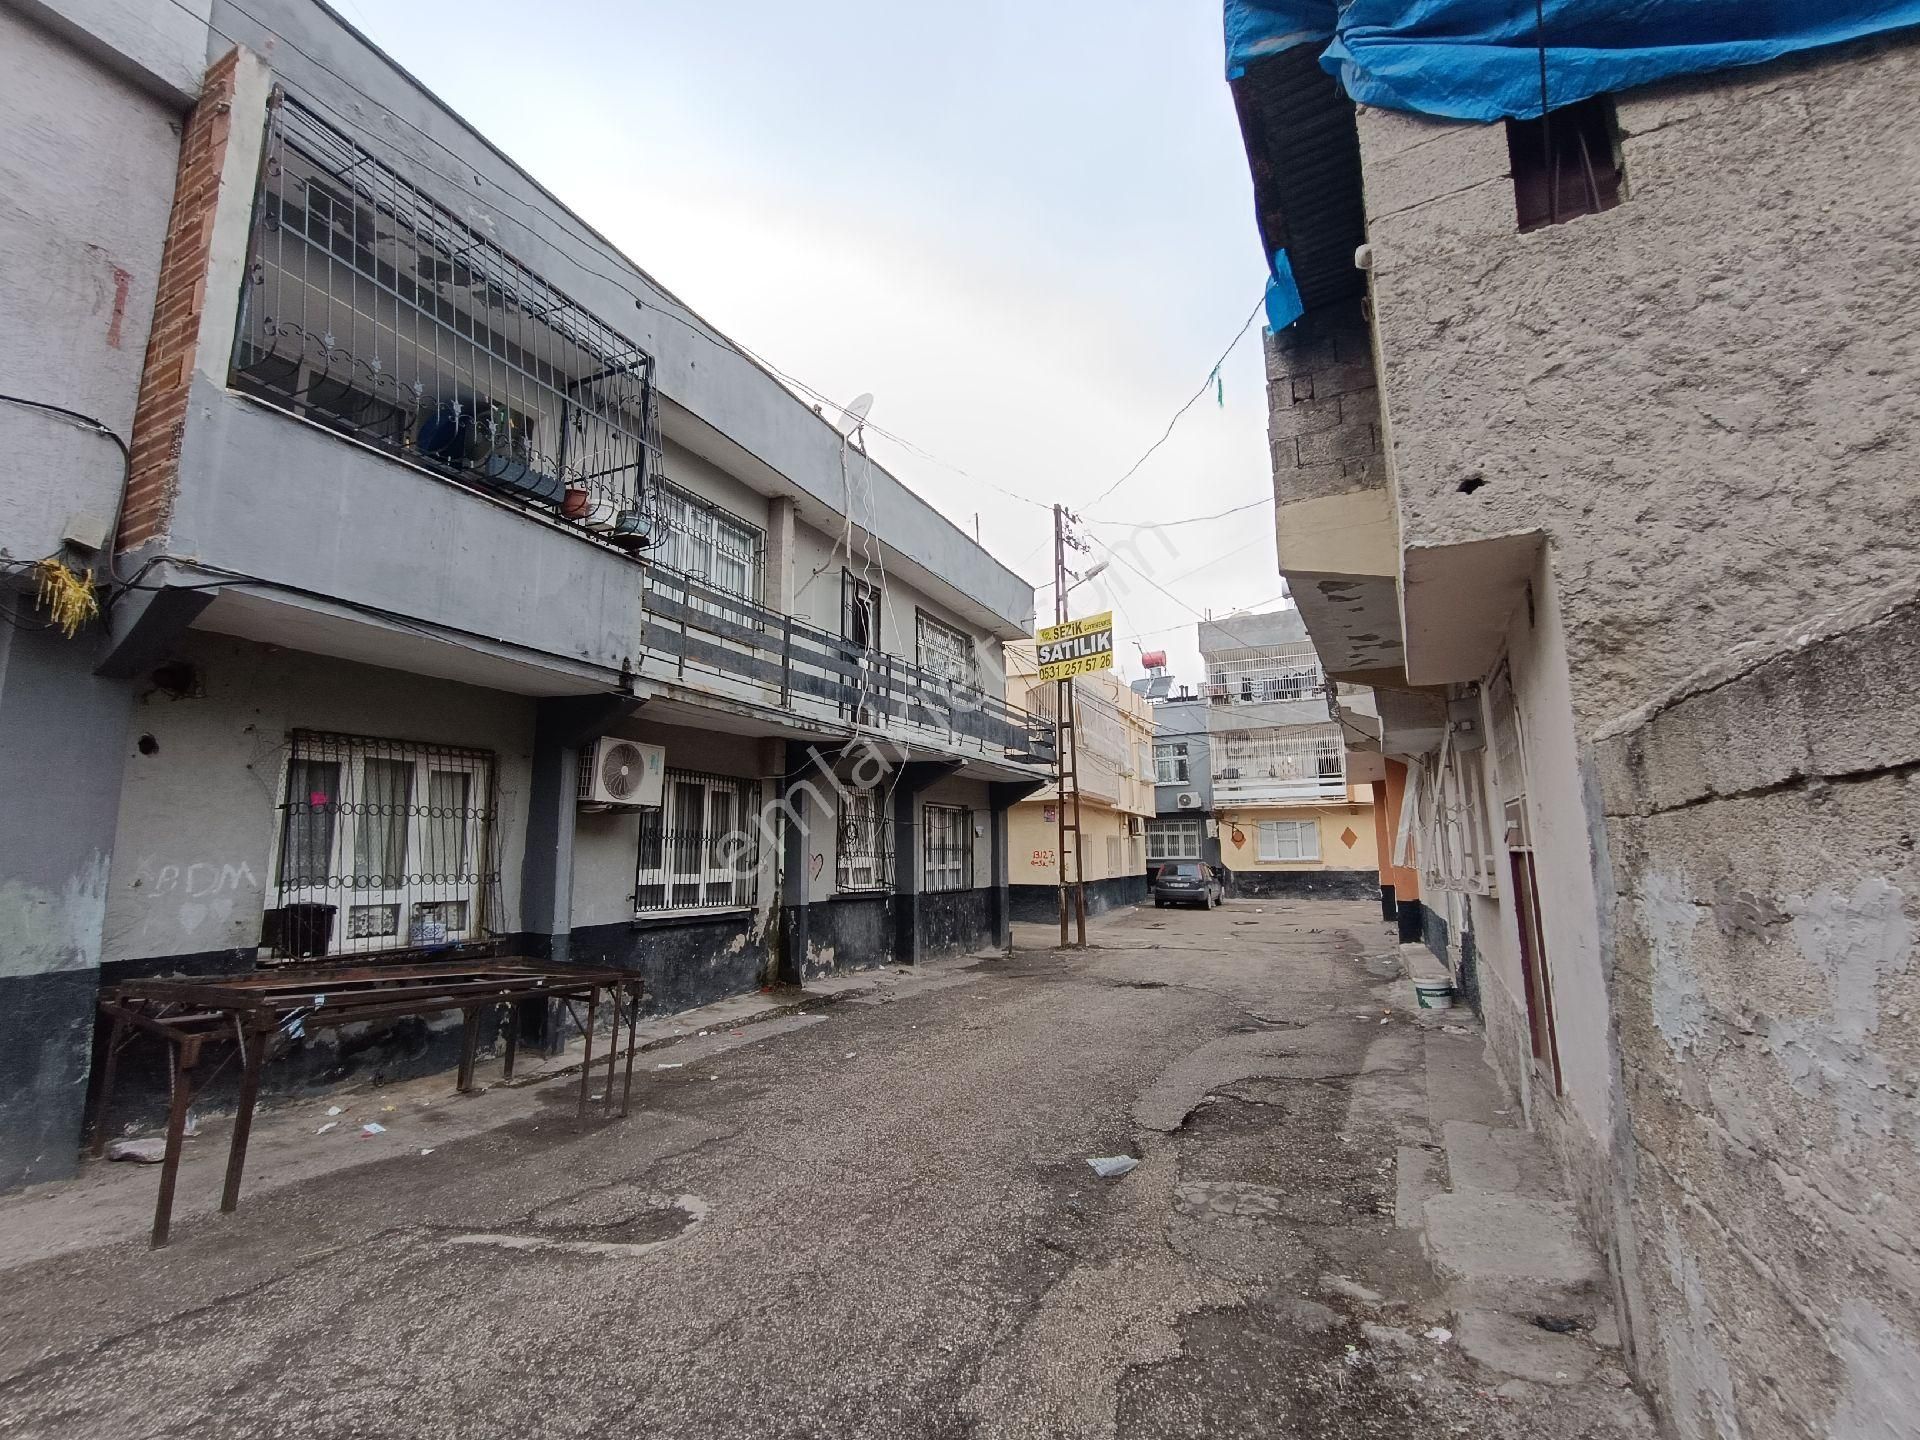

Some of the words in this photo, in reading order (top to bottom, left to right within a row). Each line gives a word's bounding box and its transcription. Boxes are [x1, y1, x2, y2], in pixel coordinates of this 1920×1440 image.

[1039, 631, 1111, 664] SATILIK
[1039, 665, 1060, 680] 0531
[1064, 661, 1082, 676] 257
[1085, 657, 1097, 672] 57
[1099, 654, 1111, 668] 26
